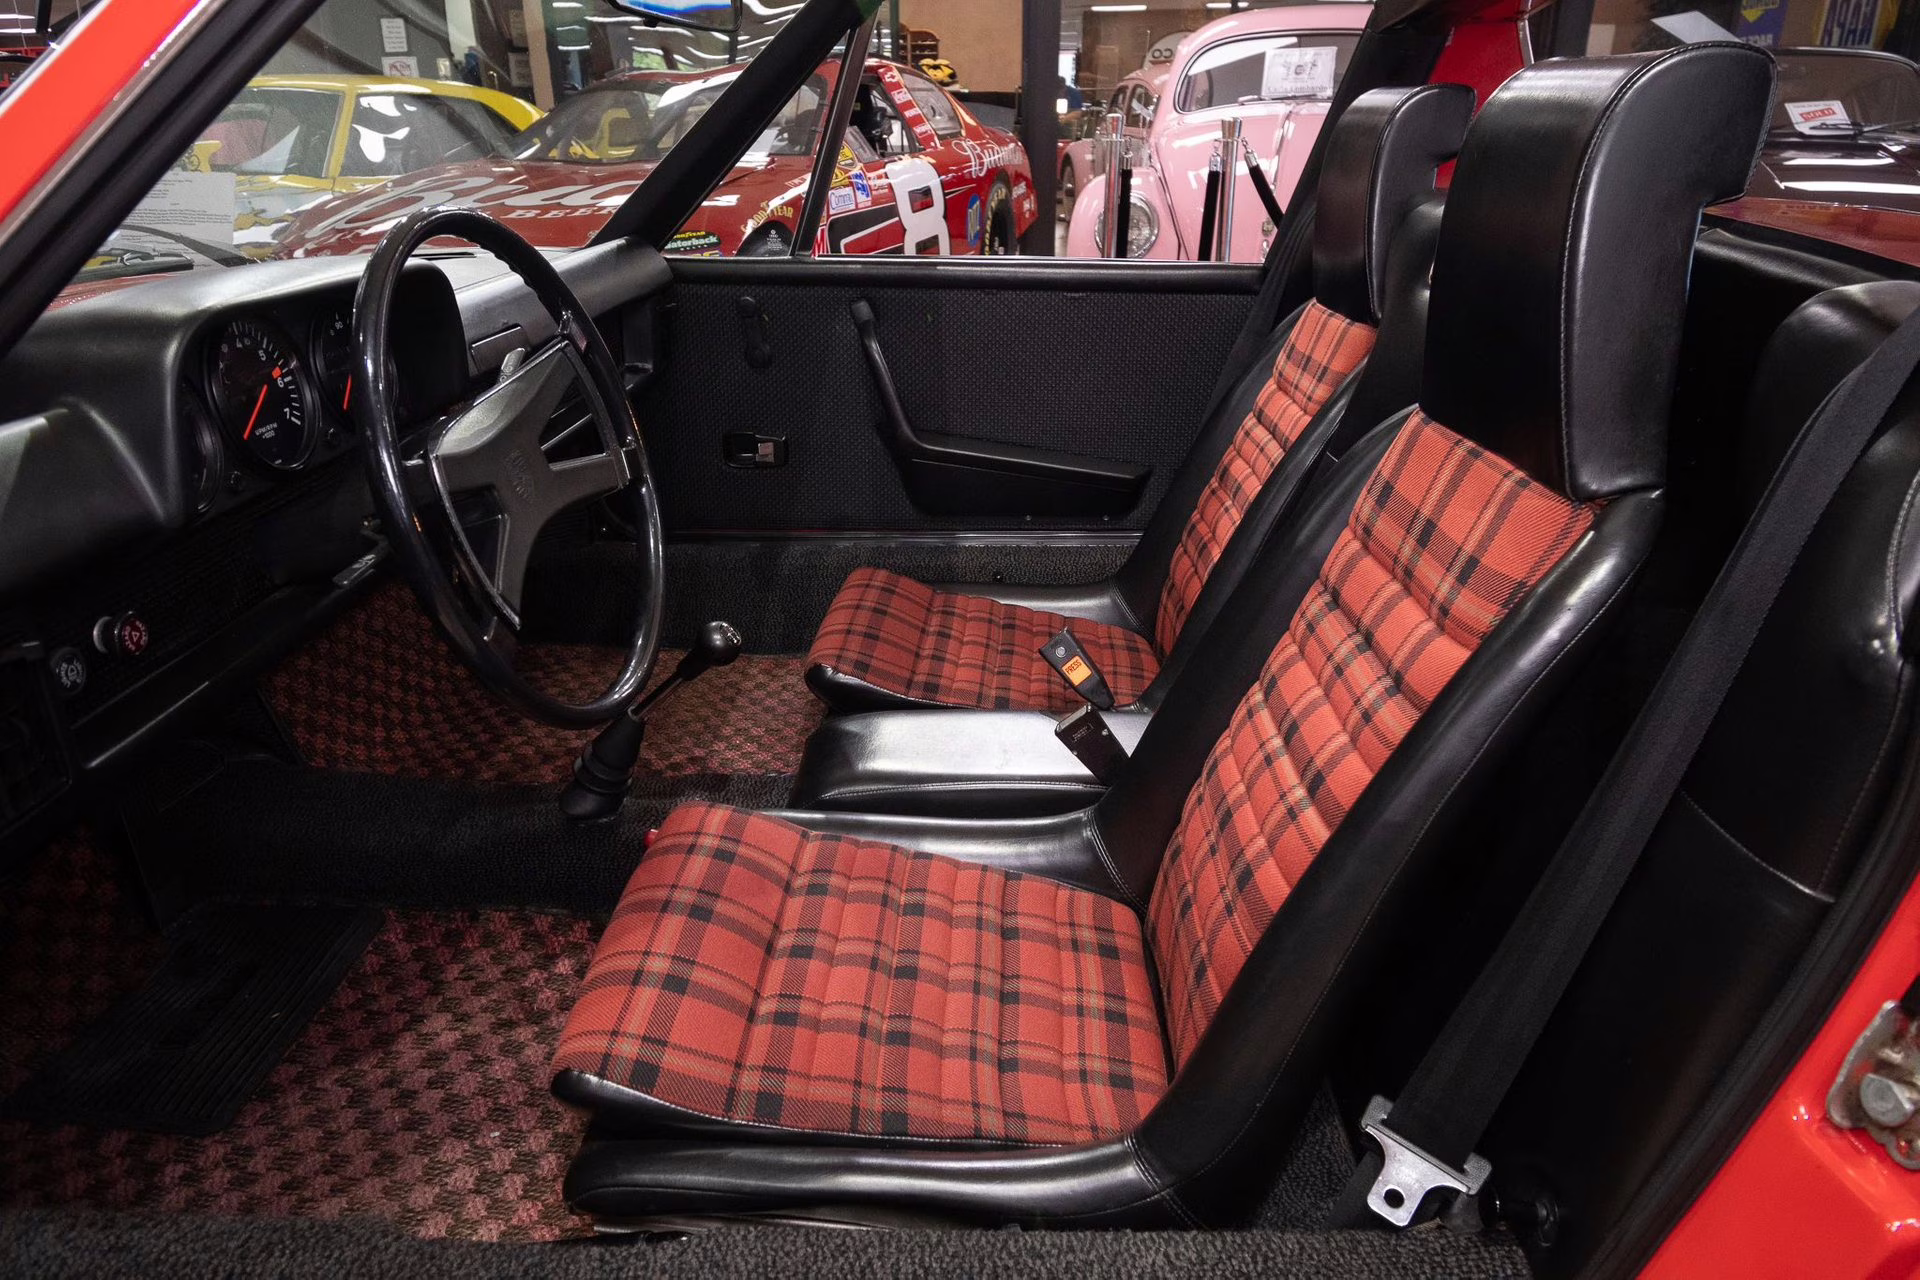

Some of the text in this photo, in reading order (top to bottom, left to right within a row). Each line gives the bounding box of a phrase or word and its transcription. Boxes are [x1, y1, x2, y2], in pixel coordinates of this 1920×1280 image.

[886, 157, 951, 257] 8
[258, 350, 267, 361] 5
[276, 377, 285, 388] 6
[283, 407, 291, 420] 7
[1065, 659, 1083, 675] PRESS
